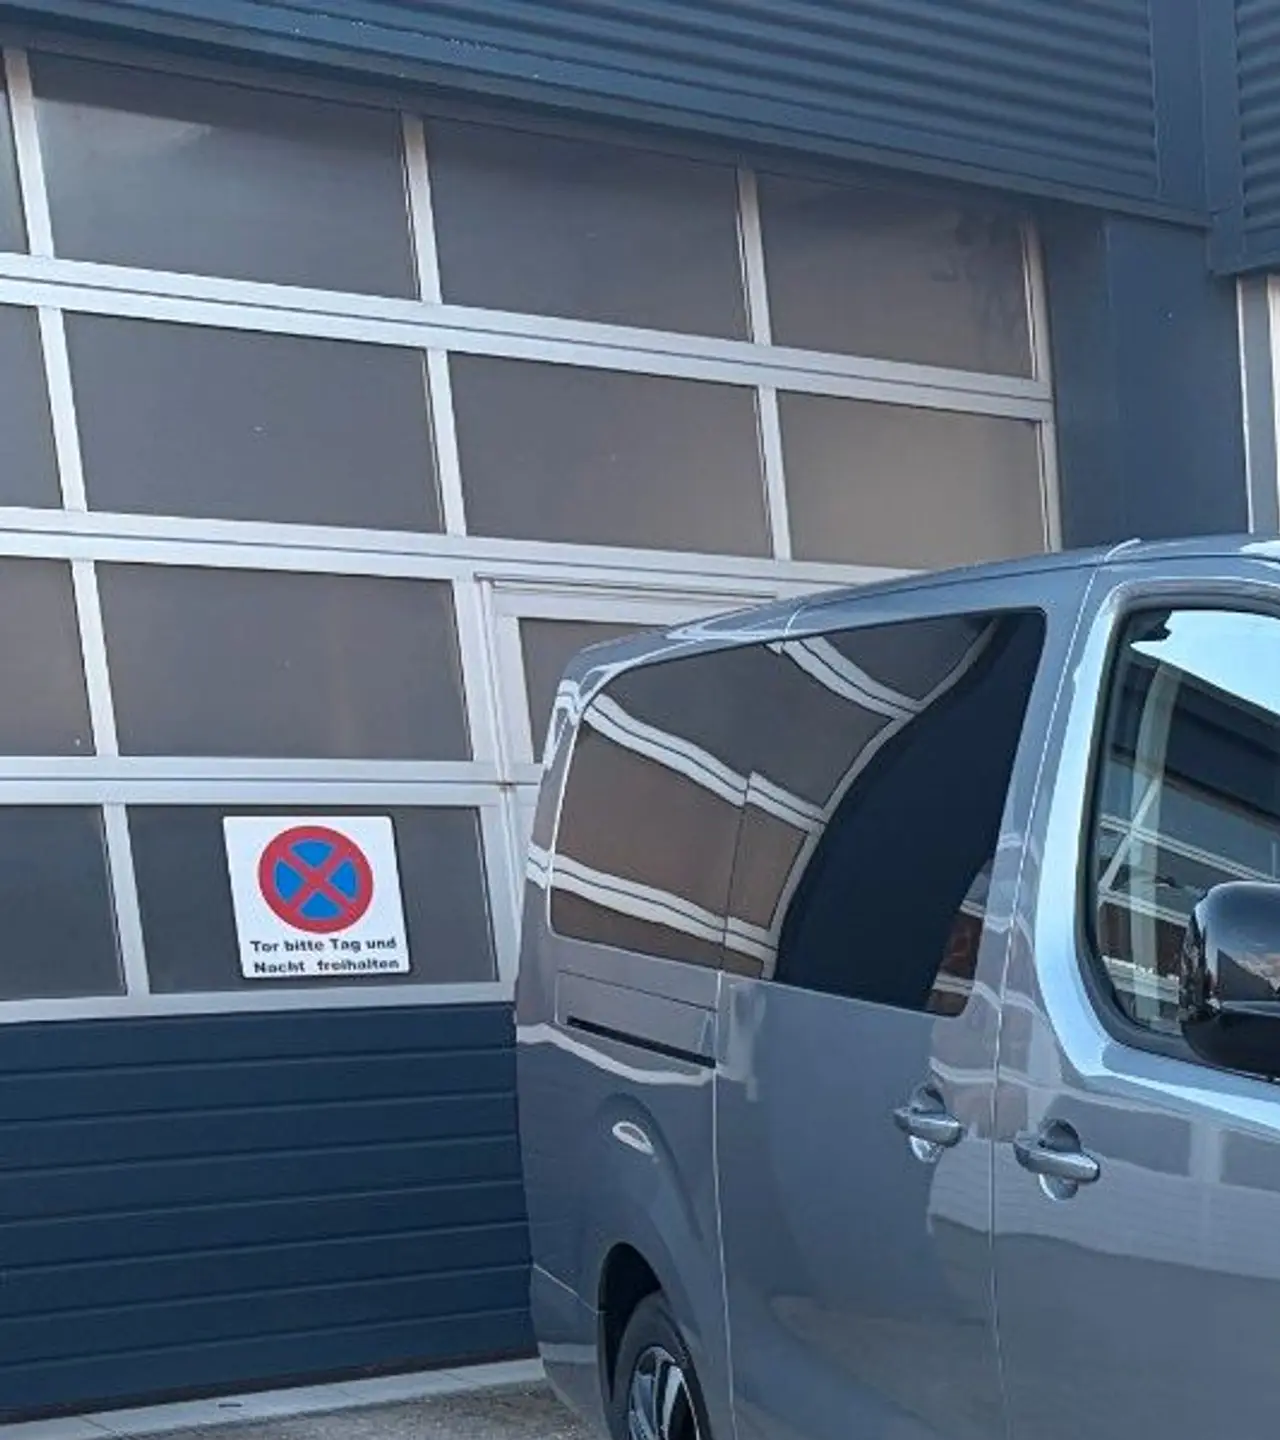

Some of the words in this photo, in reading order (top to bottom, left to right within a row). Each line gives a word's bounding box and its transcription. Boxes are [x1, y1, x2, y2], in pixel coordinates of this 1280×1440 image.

[250, 940, 279, 952] Tor
[284, 939, 325, 952] bitte
[329, 938, 361, 954] Tag
[365, 937, 397, 949] und
[254, 960, 306, 973] Nacht
[317, 958, 400, 971] freihalten
